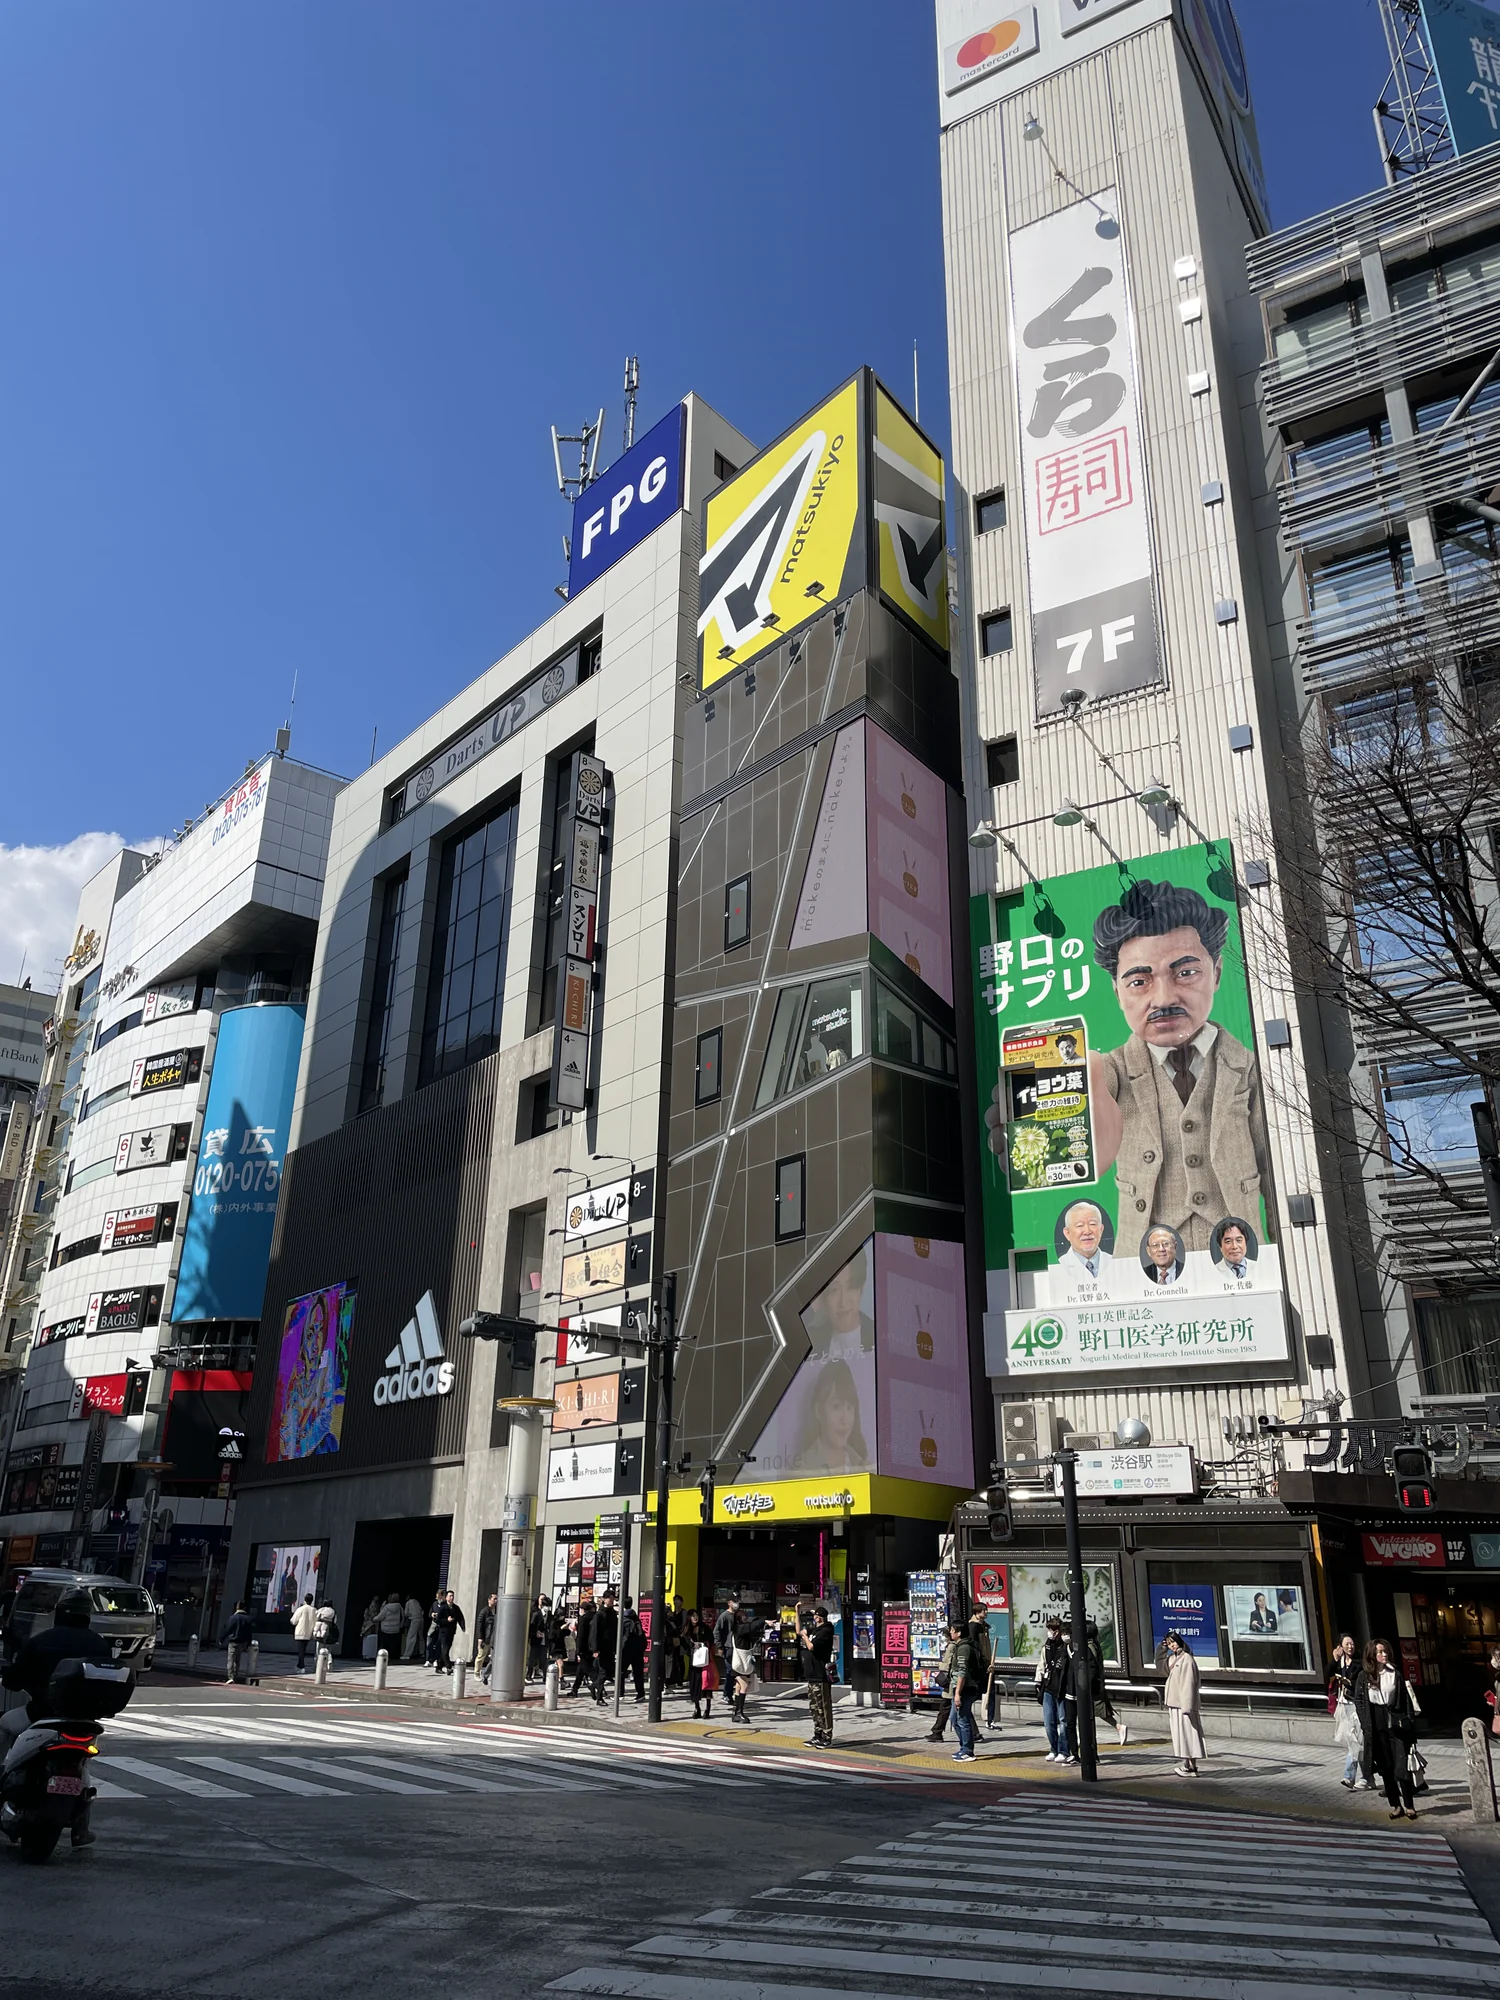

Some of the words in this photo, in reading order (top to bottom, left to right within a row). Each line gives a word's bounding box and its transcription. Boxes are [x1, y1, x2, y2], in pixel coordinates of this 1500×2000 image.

[959, 46, 1019, 81] mastercard
[1023, 266, 1125, 438] くら
[1044, 440, 1123, 522] 寿司
[581, 456, 667, 559] FPG
[780, 433, 844, 584] matsukiyo
[1056, 613, 1136, 674] 7F
[445, 735, 484, 776] Darts
[491, 694, 527, 745] UP
[224, 771, 261, 818] 貸広告
[579, 790, 600, 805] Darts
[213, 781, 267, 846] 0120-075-787
[577, 799, 600, 819] UP
[571, 904, 586, 953] スシロー
[979, 934, 1085, 979] 野口の
[981, 965, 1092, 1016] サプリ
[812, 1007, 848, 1026] matsukiyo
[825, 1017, 850, 1031] studio
[564, 1065, 581, 1075] adidas
[606, 1192, 627, 1218] UP
[1077, 1282, 1098, 1293] 創立者
[1143, 1287, 1155, 1297] Dr.
[1156, 1286, 1189, 1297] Gonnella
[1223, 1282, 1236, 1291] Dr.
[1237, 1280, 1253, 1290] 佐藤
[104, 1291, 140, 1306] ダーツバー
[1067, 1294, 1078, 1303] Dr.
[1079, 1293, 1094, 1303] 浅野
[100, 1312, 137, 1328] BAGUS
[1077, 1307, 1154, 1325] 野口英世記念
[54, 1320, 85, 1339] ダーツバー
[1010, 1317, 1063, 1357] 40
[1079, 1317, 1255, 1352] 野口医学研究所
[1010, 1356, 1073, 1369] ANNIVERSARY
[1080, 1352, 1110, 1363] Noguchi
[1112, 1350, 1141, 1361] Medical
[1142, 1349, 1178, 1360] Research
[1180, 1347, 1215, 1358] Institute
[1216, 1346, 1239, 1355] Since
[1240, 1344, 1257, 1354] 1983
[373, 1361, 455, 1407] adidas
[88, 1395, 125, 1409] クリニック
[218, 1451, 243, 1460] adidas
[1111, 1454, 1153, 1470] 渋谷駅
[585, 1468, 598, 1478] Press
[599, 1466, 612, 1475] Room
[804, 1493, 852, 1509] matsukiyo
[1369, 1536, 1436, 1559] VANGUARD
[1162, 1598, 1203, 1609] MIZUHO
[882, 1670, 909, 1679] TaxFree
